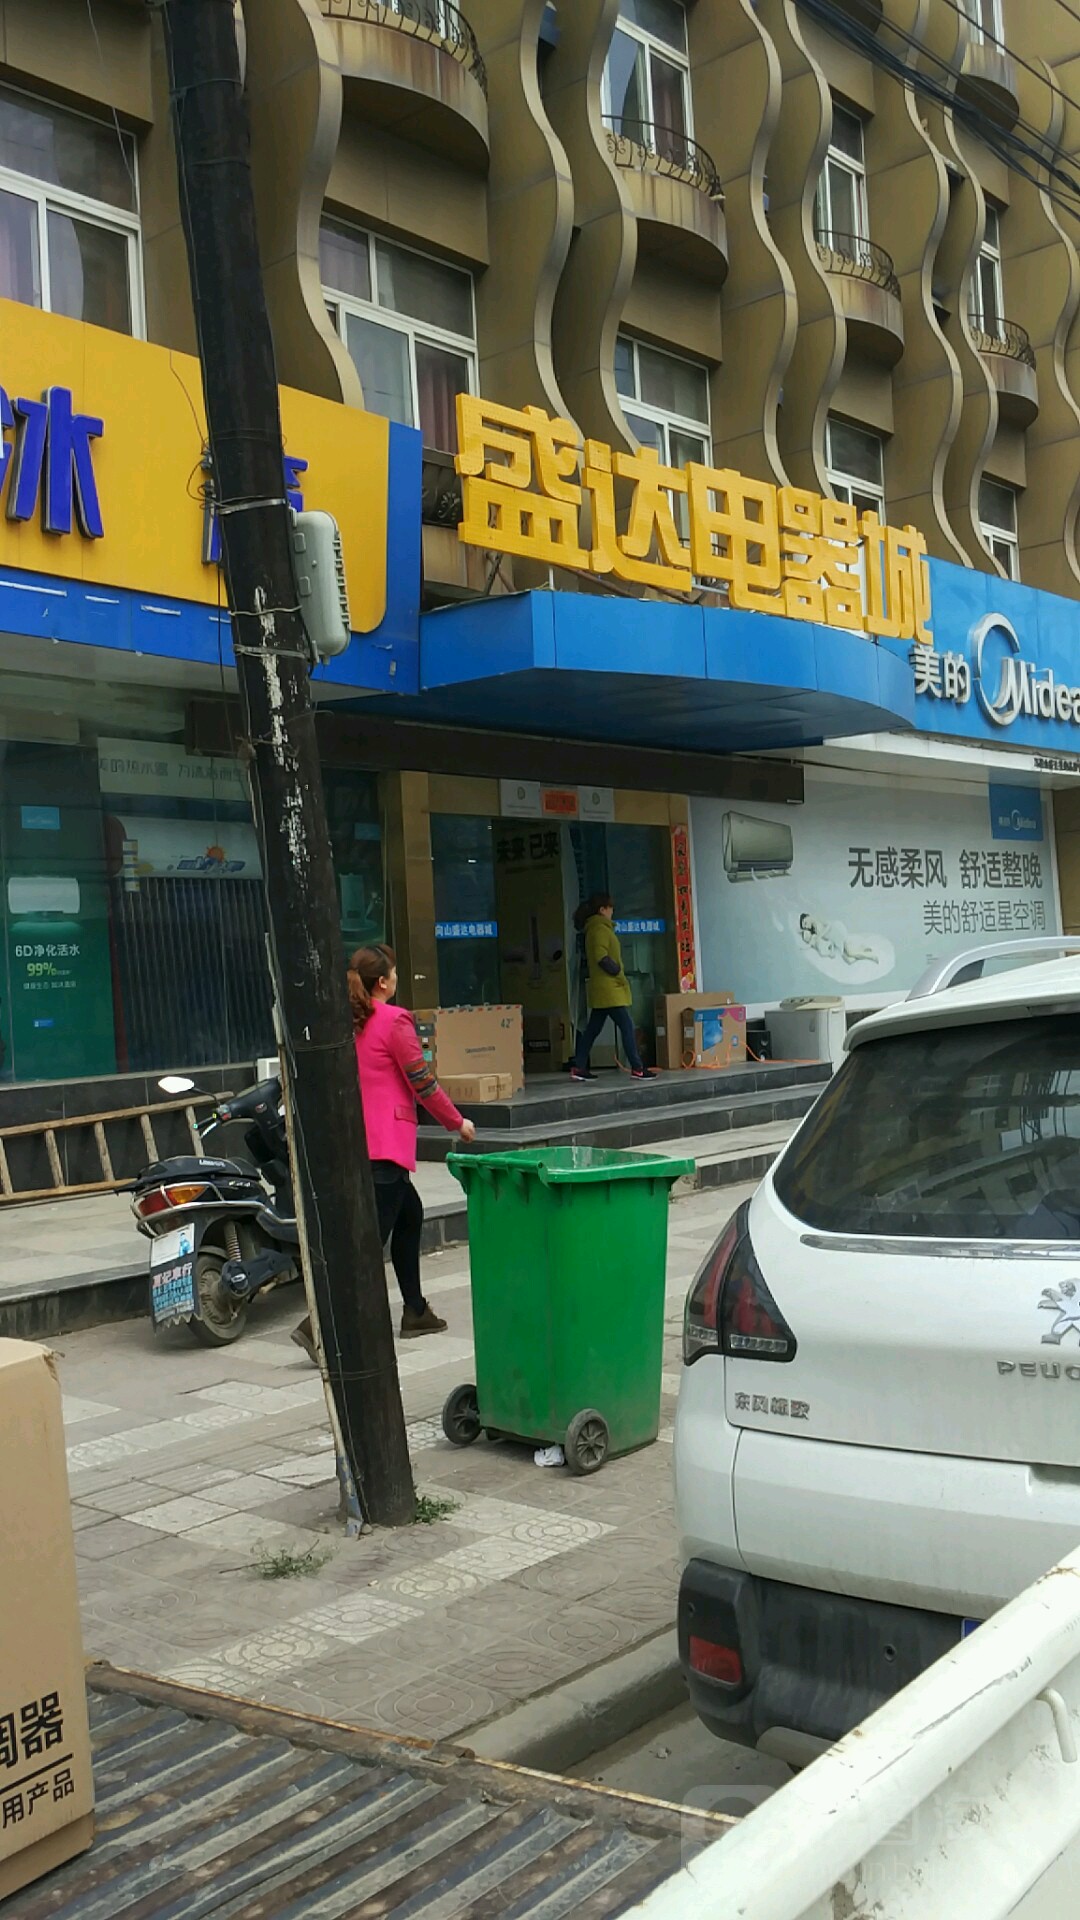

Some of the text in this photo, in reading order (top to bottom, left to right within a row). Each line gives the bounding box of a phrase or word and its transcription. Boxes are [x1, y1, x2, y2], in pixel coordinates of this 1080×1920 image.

[0, 384, 104, 540] 水
[455, 393, 934, 645] 盛达电器城
[909, 612, 1080, 727] 美的 Midea
[848, 846, 1043, 889] 无感柔风 舒适整晚
[923, 899, 1046, 935] 美的舒适星空调
[15, 944, 81, 958] 6D净化活水
[26, 962, 57, 977] 99%
[2, 1768, 75, 1830] 用产品
